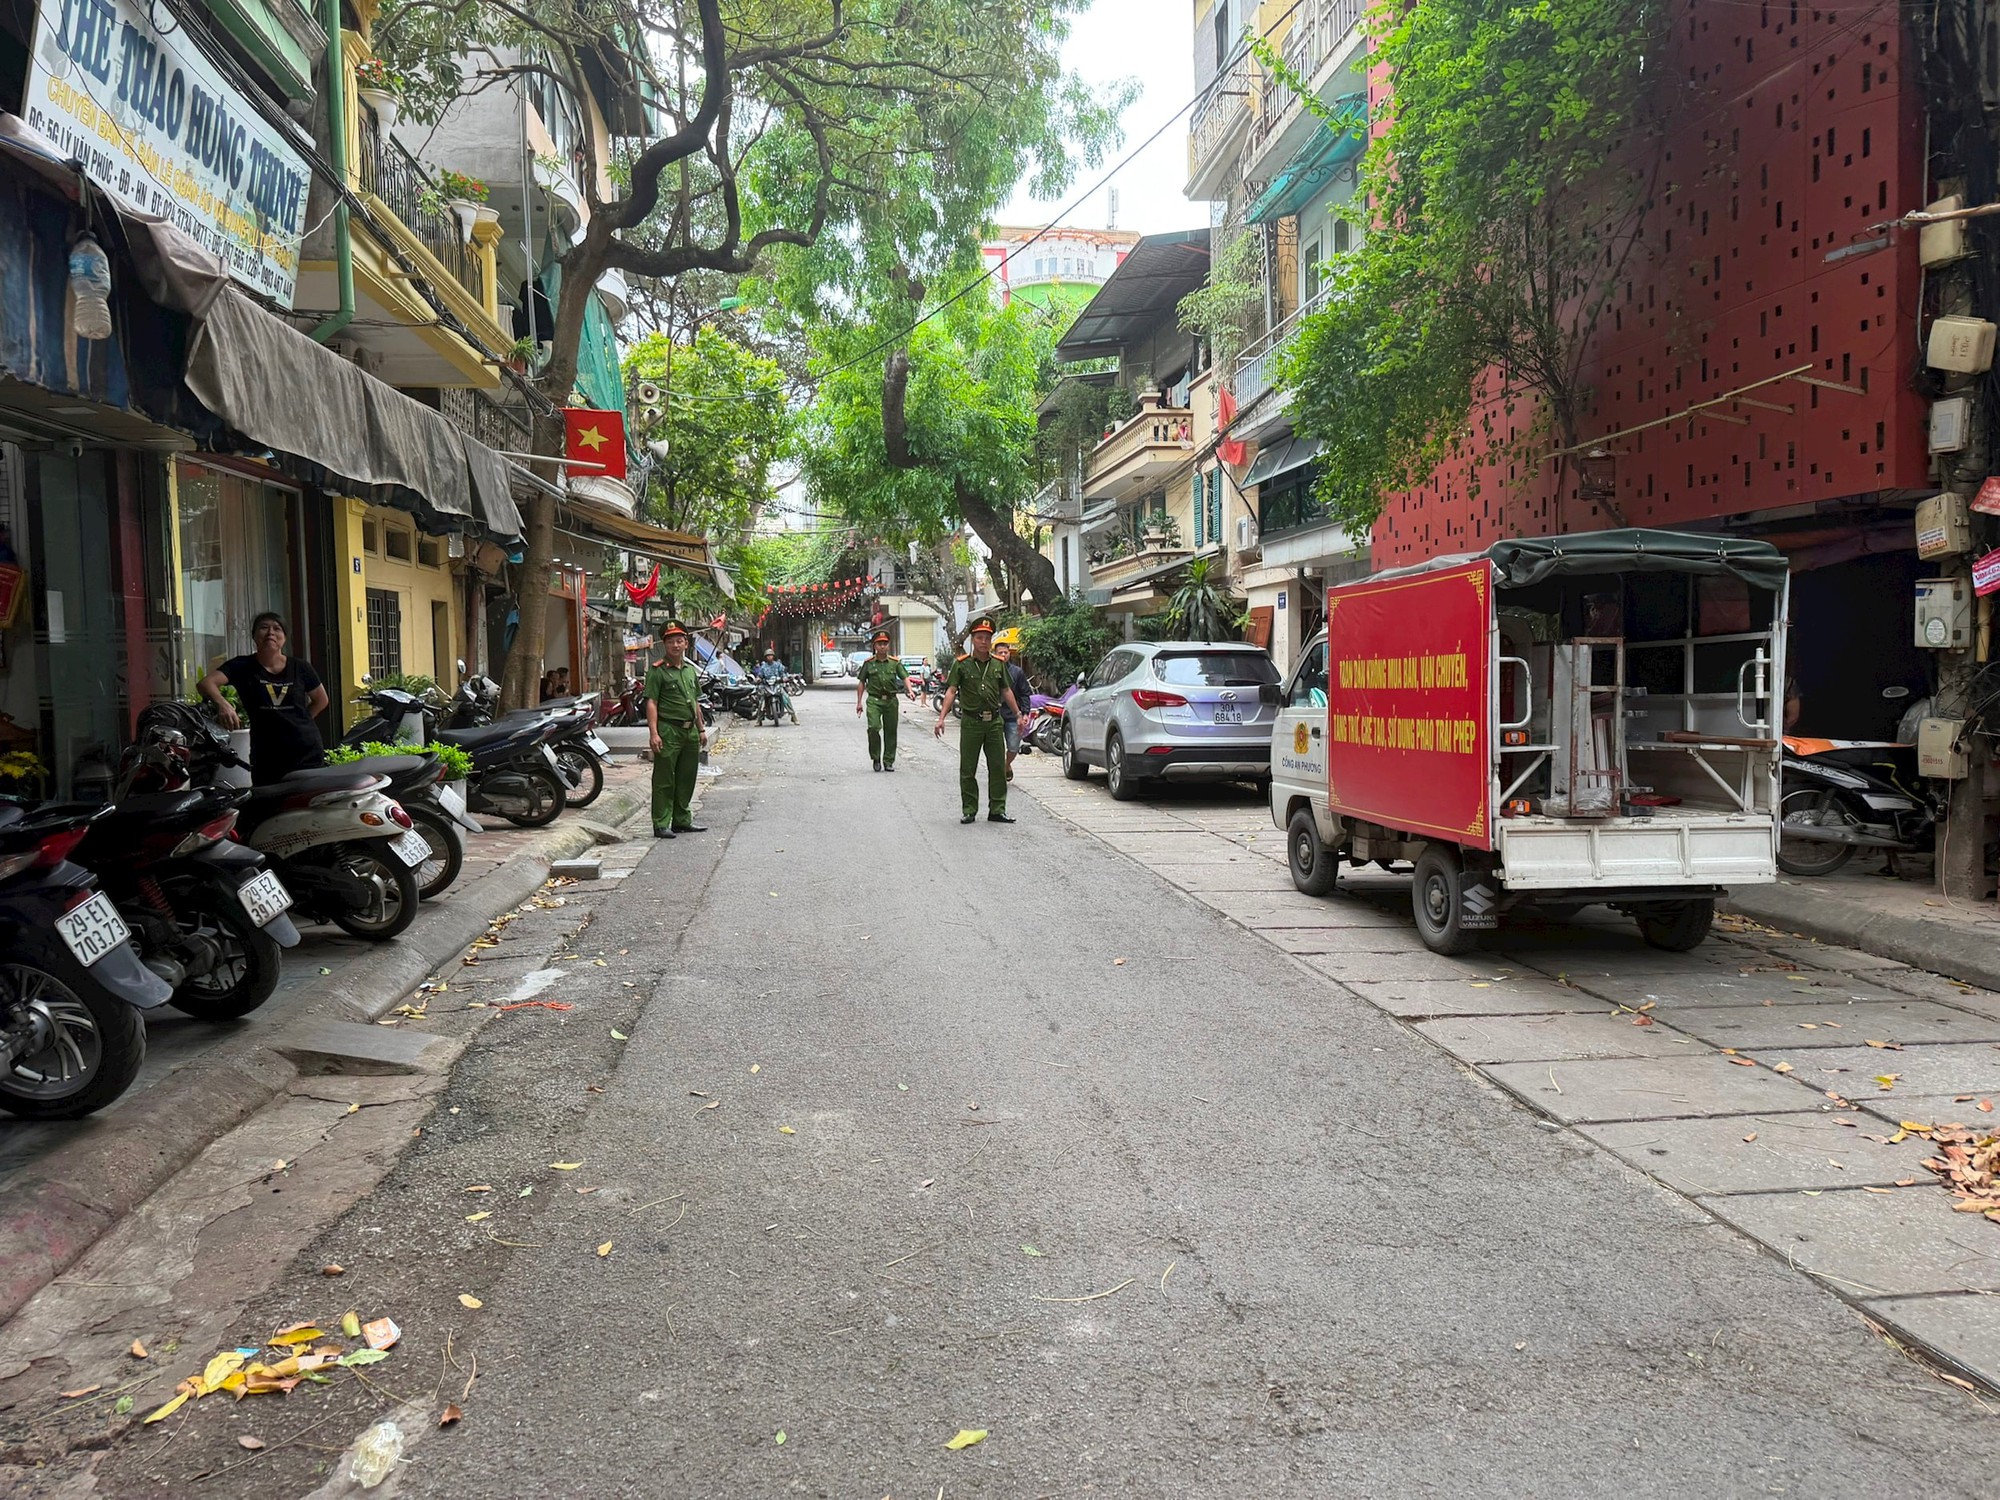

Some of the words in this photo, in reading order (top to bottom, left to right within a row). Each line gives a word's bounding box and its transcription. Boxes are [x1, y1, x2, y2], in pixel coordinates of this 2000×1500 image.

[47, 76, 97, 131] CHUYÊN
[97, 114, 121, 149] BÁN
[60, 126, 72, 153] LÝ
[73, 134, 91, 169] VĂN
[90, 152, 113, 185] PHÚC
[135, 180, 147, 207] HN
[1339, 654, 1353, 688] TOÀN
[1354, 654, 1366, 688] DÂN
[1366, 652, 1386, 689] KHÔNG
[1388, 658, 1402, 688] MUA
[1403, 650, 1419, 693] BÁN,
[1420, 649, 1434, 695] VẬN
[1215, 713, 1242, 722] 684.18
[1220, 703, 1235, 712] 30A
[1387, 704, 1397, 748] SỬ
[1397, 718, 1415, 756] DỤNG
[1416, 712, 1434, 751] PHÁO
[1436, 712, 1452, 753] TRÁI
[1453, 712, 1476, 755] PHÉP
[1282, 756, 1294, 769] CÔNG
[1294, 760, 1301, 770] AN
[404, 843, 427, 864] 3536
[245, 876, 276, 906] 29-E2
[251, 889, 290, 923] 391.31
[66, 899, 108, 938] 29-E1
[74, 917, 125, 962] 703.73
